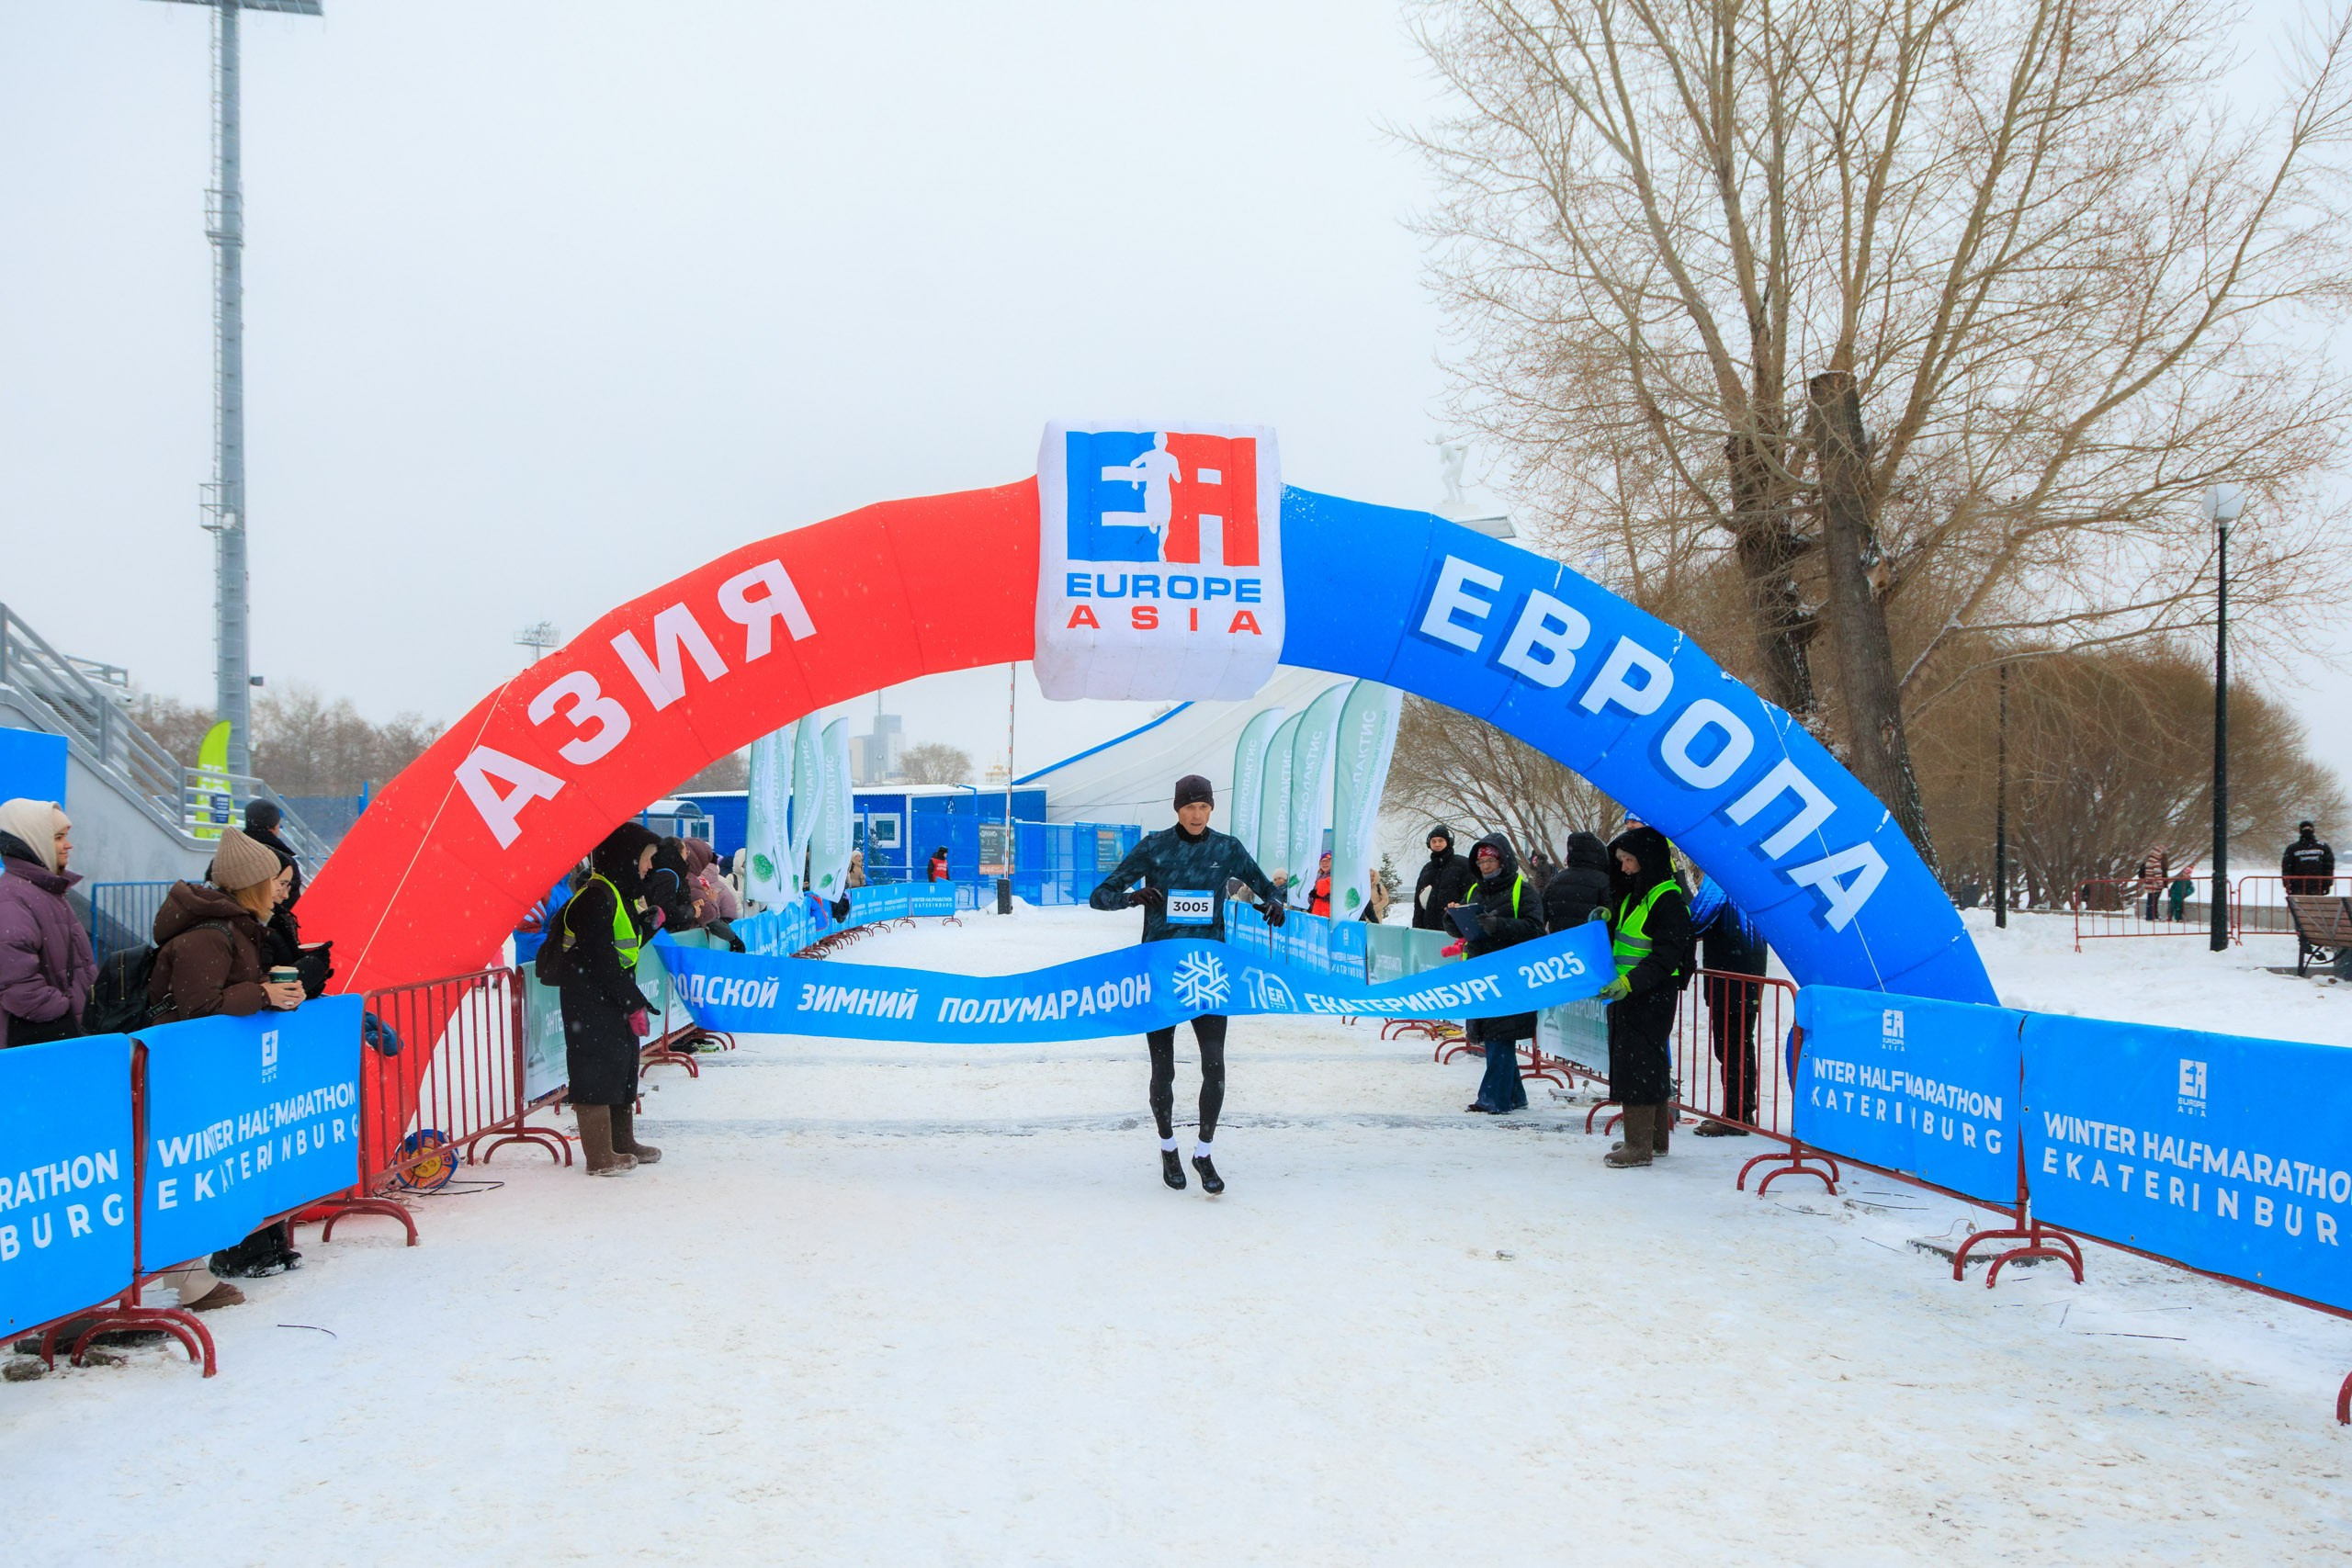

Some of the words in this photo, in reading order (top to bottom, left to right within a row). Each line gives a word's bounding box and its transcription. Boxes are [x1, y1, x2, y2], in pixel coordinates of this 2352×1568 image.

[1067, 572, 1261, 604] EUROPE
[1067, 604, 1262, 636] ASIA
[454, 558, 818, 851] АЗИЯ
[1419, 555, 1889, 933] ЕВРОПА
[825, 754, 837, 855] ЭНТЕРОЛАКТИС
[1238, 739, 1258, 836] ЭНТЕРОЛАКТИС
[1275, 749, 1293, 860] ЭНТЕРОЛАКТИС
[1295, 730, 1323, 852] ЭНЕРОЛАКТИС
[1173, 901, 1209, 912] 3005
[797, 983, 919, 1021] ЗИМНИЙ
[938, 972, 1151, 1024] ПОЛУМАРАФОН
[1304, 975, 1503, 1013] ЕКАТЕРИНБУРГ
[1519, 951, 1586, 989] 2025
[1814, 1057, 1856, 1085] NTER
[157, 1118, 233, 1168] WINTER
[158, 1114, 358, 1211] EKATERINBURG
[2043, 1111, 2136, 1156] WINTER
[2143, 1131, 2352, 1205] HALFMARATHO
[0, 1193, 124, 1262] BURG
[2042, 1146, 2339, 1247] EKATERINBUR
